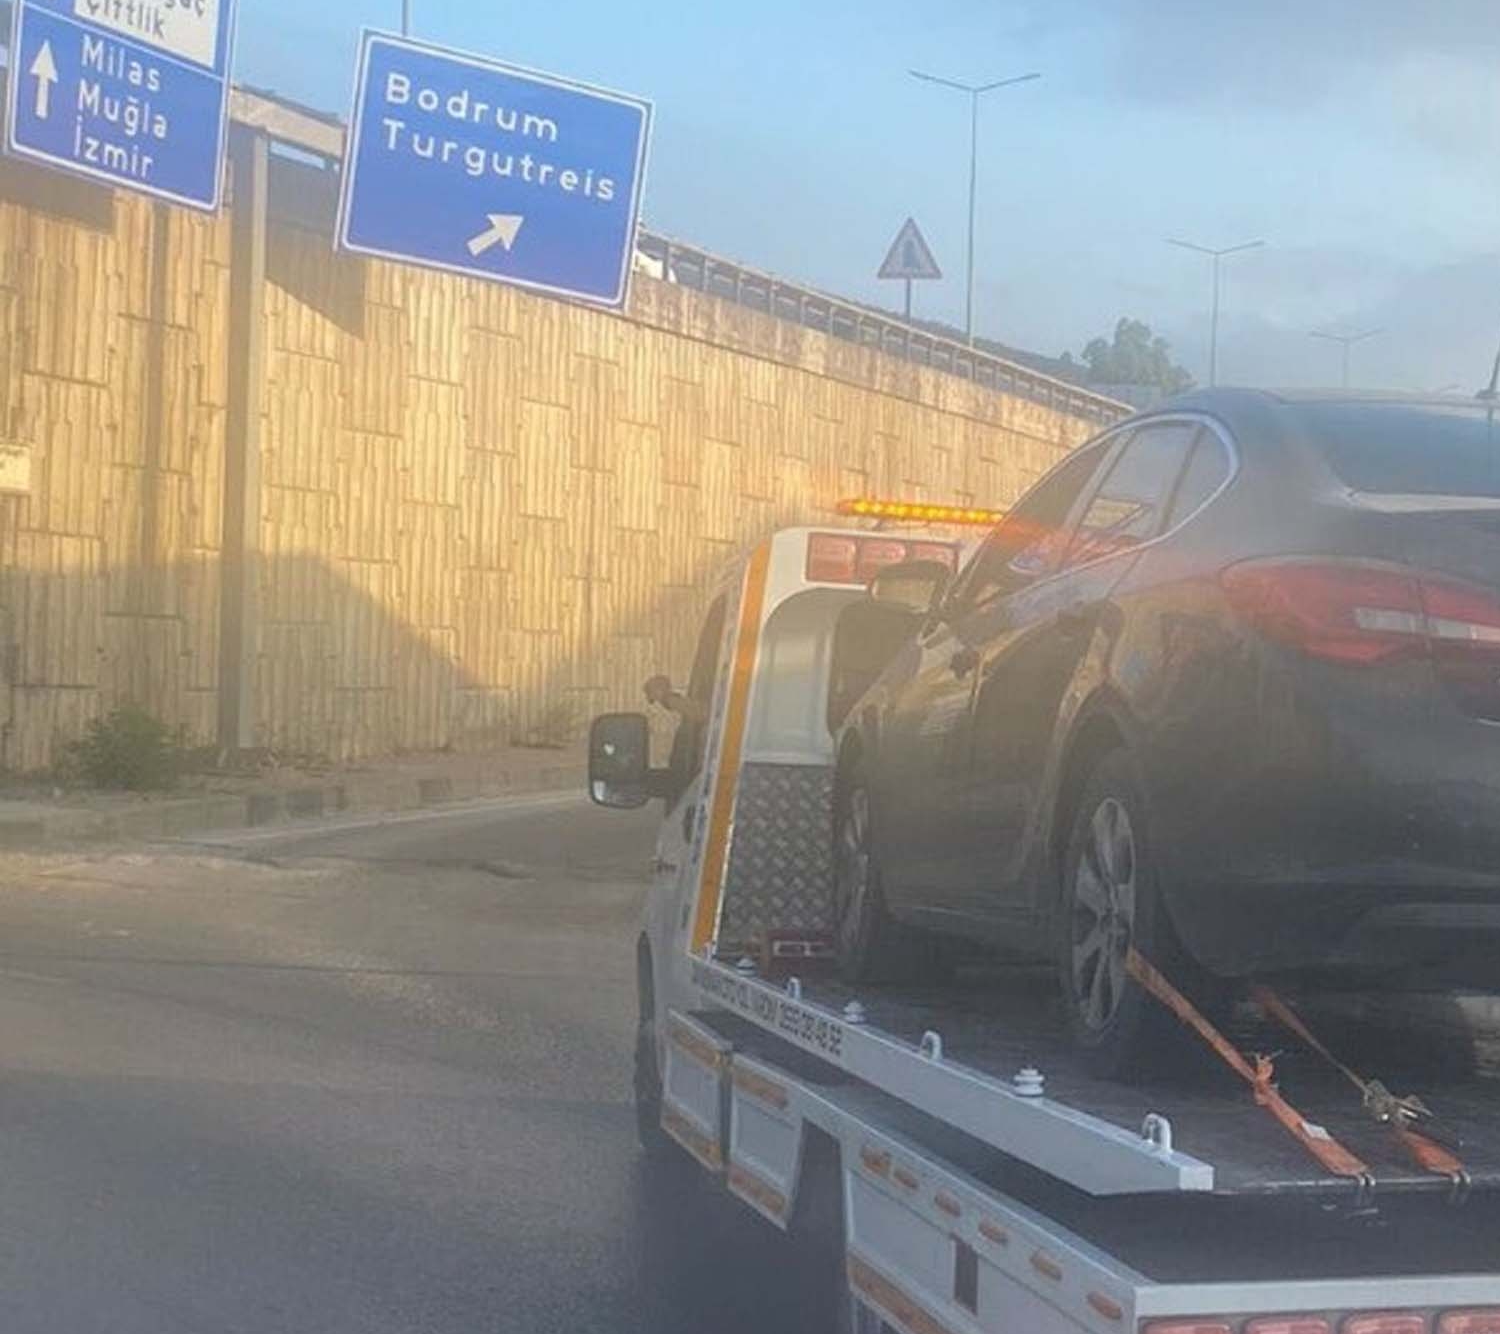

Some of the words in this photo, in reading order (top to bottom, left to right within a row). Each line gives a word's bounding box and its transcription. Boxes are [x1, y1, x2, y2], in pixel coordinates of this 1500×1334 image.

[82, 33, 161, 92] Milas
[78, 78, 168, 139] Muğla
[385, 71, 559, 142] Bodrum
[74, 114, 153, 178] İzmir
[383, 117, 615, 201] Turgutreis
